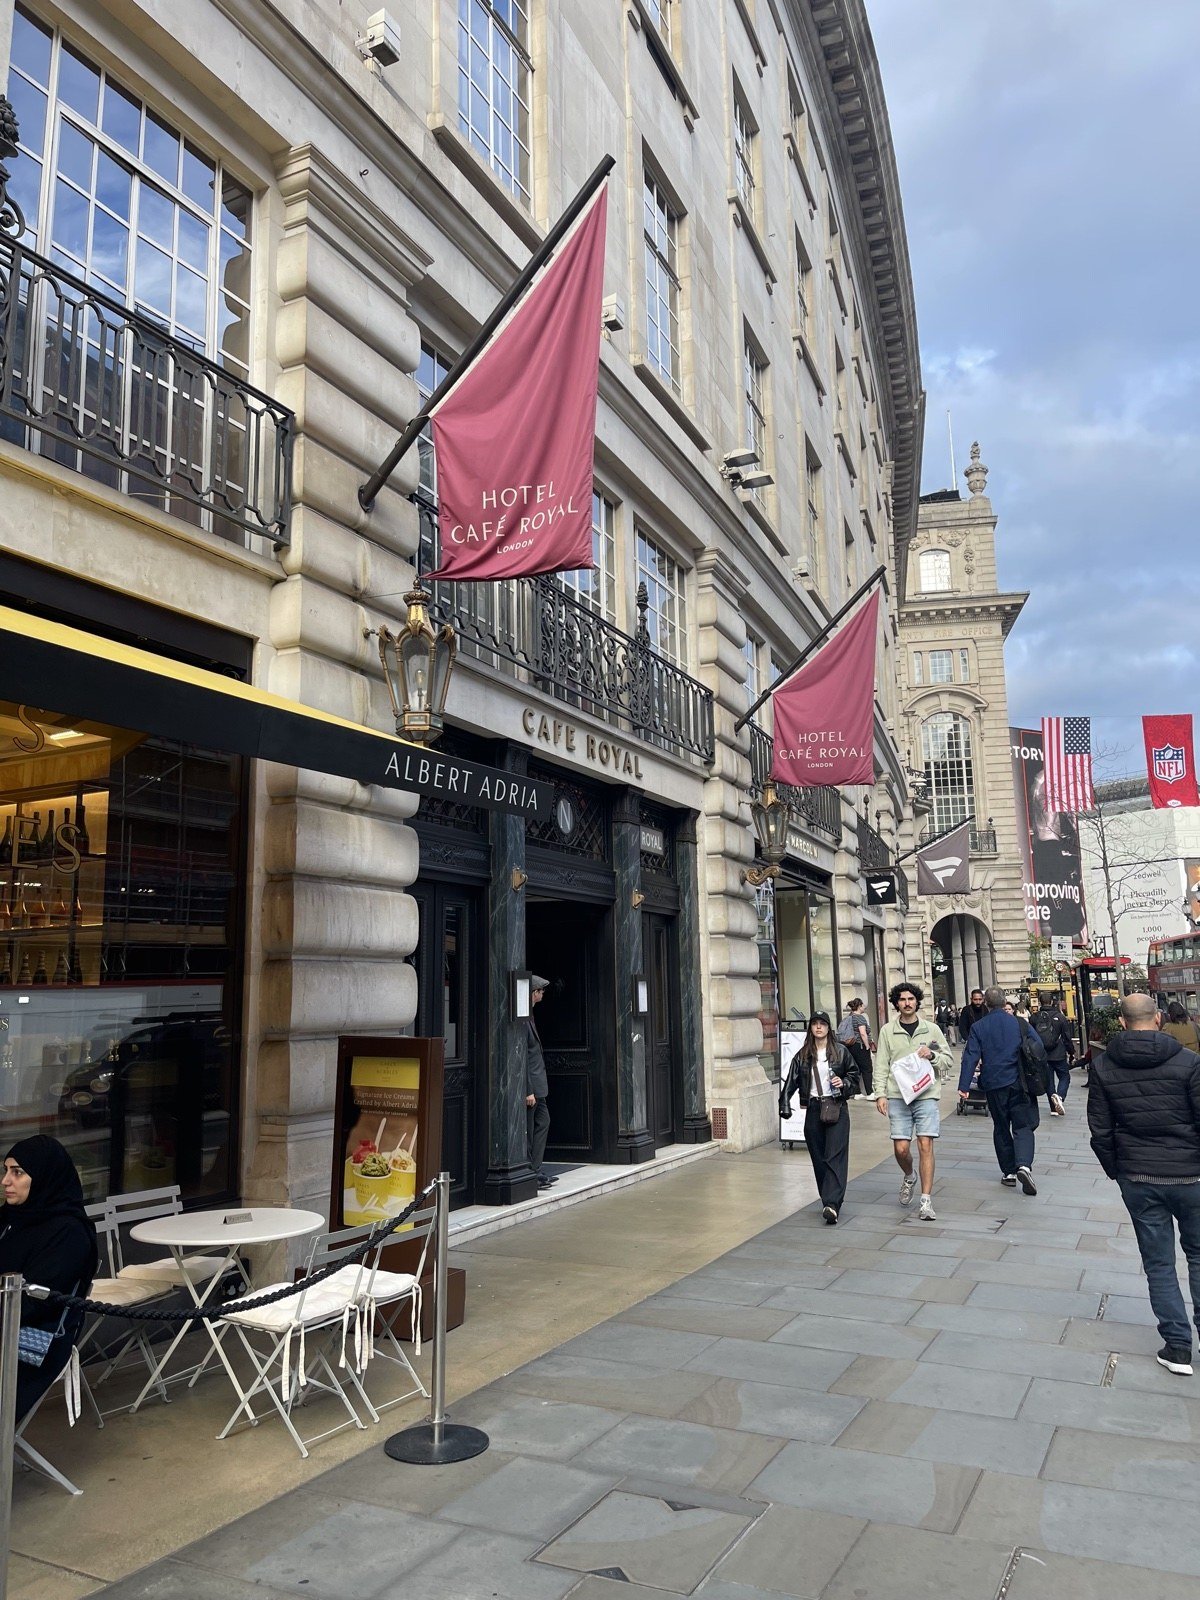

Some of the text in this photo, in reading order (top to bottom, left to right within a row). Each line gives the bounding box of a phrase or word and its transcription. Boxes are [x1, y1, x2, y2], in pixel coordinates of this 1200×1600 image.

[482, 481, 556, 510] HOTEL
[451, 495, 579, 544] CAFÉ ROYAL
[496, 538, 534, 554] LONDON
[522, 707, 644, 778] CAFE ROYAL
[798, 731, 845, 743] HOTEL
[779, 746, 867, 760] CAFÉ ROYAL
[1157, 761, 1182, 777] NFL
[384, 751, 538, 811] ALBERT ADRIA
[641, 831, 662, 851] ROYAL
[1133, 870, 1161, 880] zedwell
[1130, 887, 1168, 899] Piccadilly
[1126, 901, 1148, 909] never
